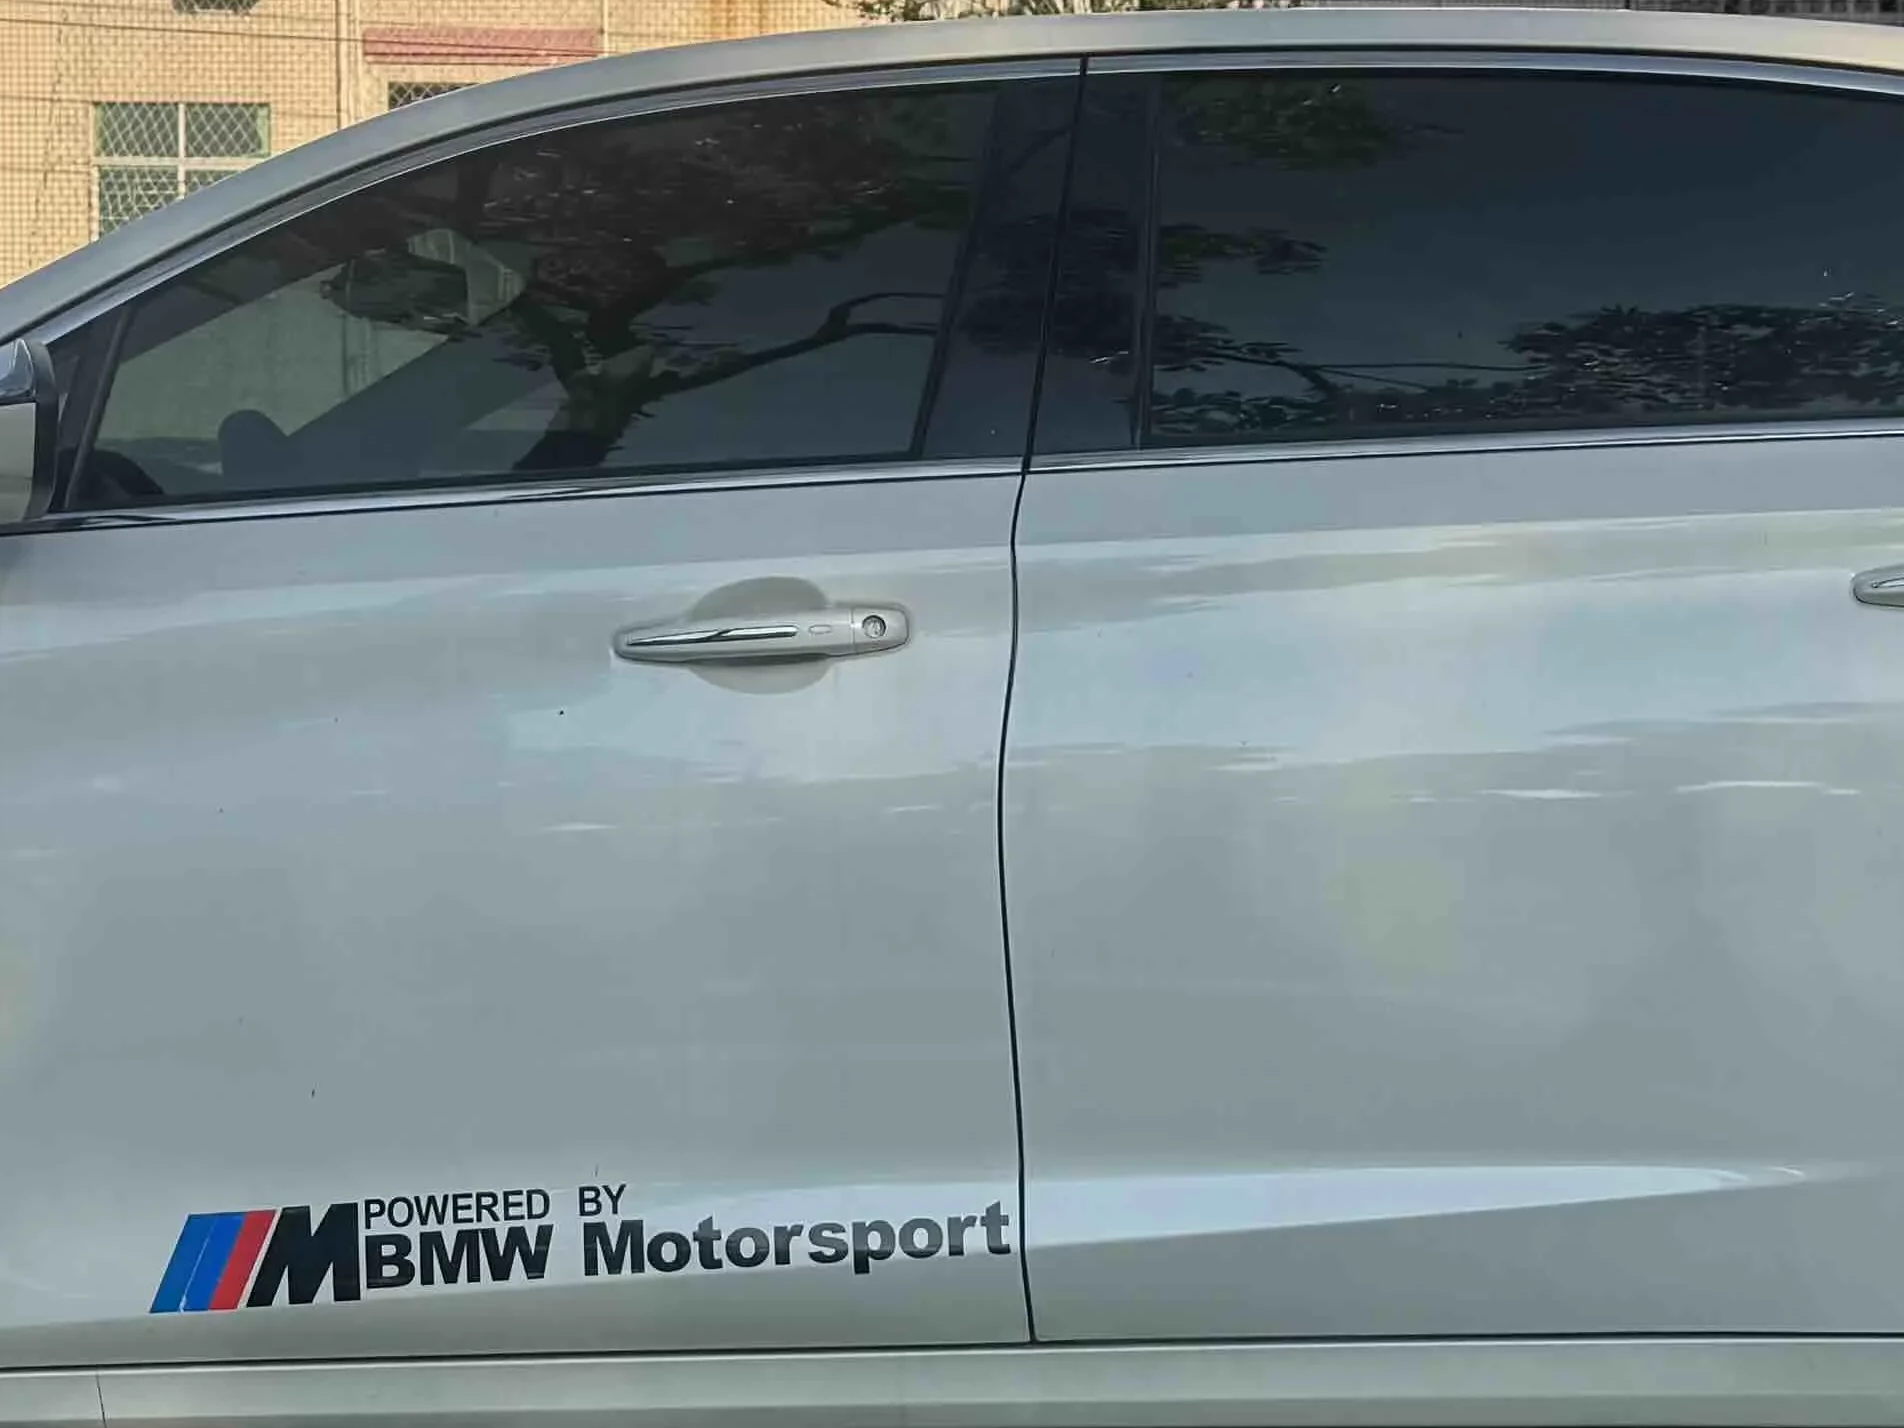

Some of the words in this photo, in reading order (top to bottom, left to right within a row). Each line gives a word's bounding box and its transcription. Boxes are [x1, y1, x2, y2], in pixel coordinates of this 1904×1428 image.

[364, 1189, 550, 1228] POWERED
[579, 1184, 626, 1215] BY
[365, 1224, 552, 1289] BMW
[584, 1200, 1010, 1275] Motorsport
